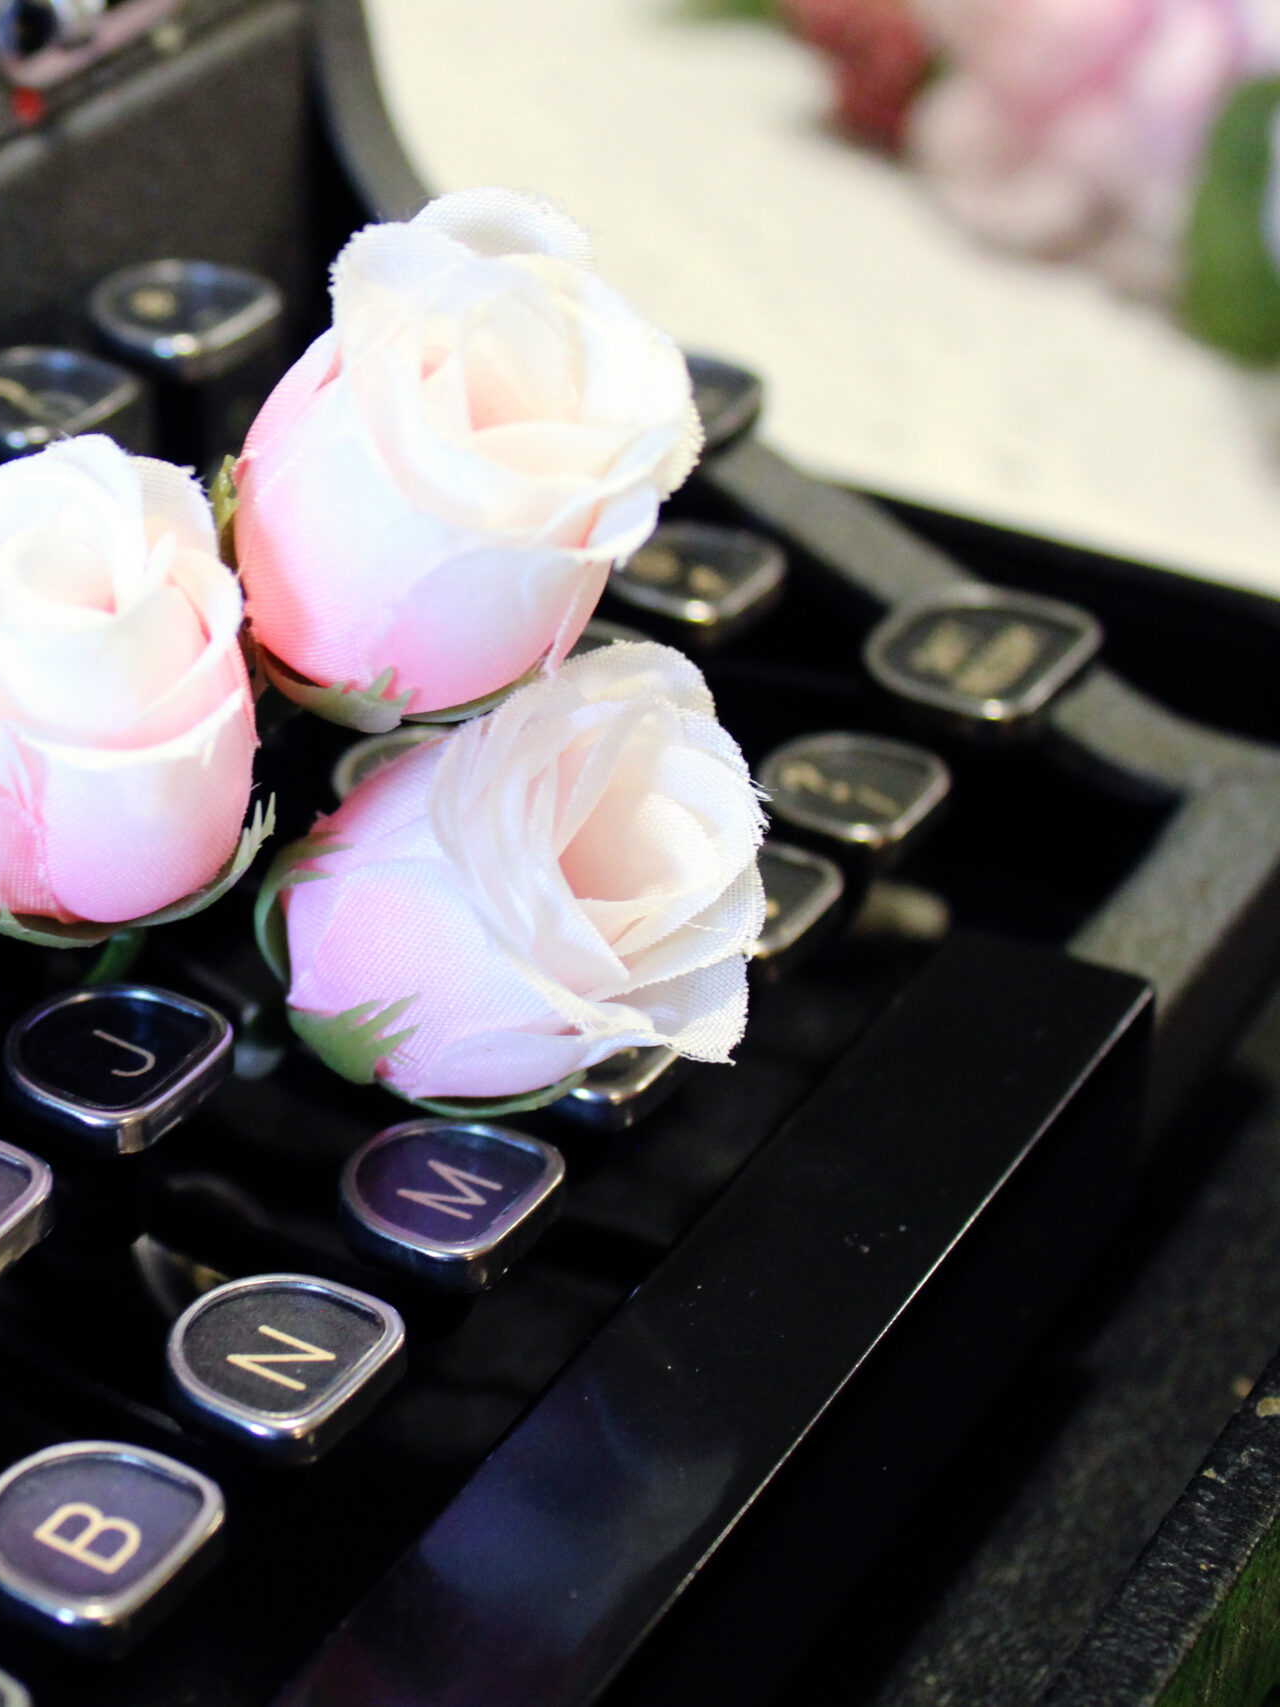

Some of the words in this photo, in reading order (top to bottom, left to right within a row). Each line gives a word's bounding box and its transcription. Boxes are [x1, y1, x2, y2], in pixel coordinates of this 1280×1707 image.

[93, 1029, 156, 1077] J
[397, 1159, 503, 1221] M
[226, 1324, 337, 1392] N
[33, 1501, 142, 1576] B
